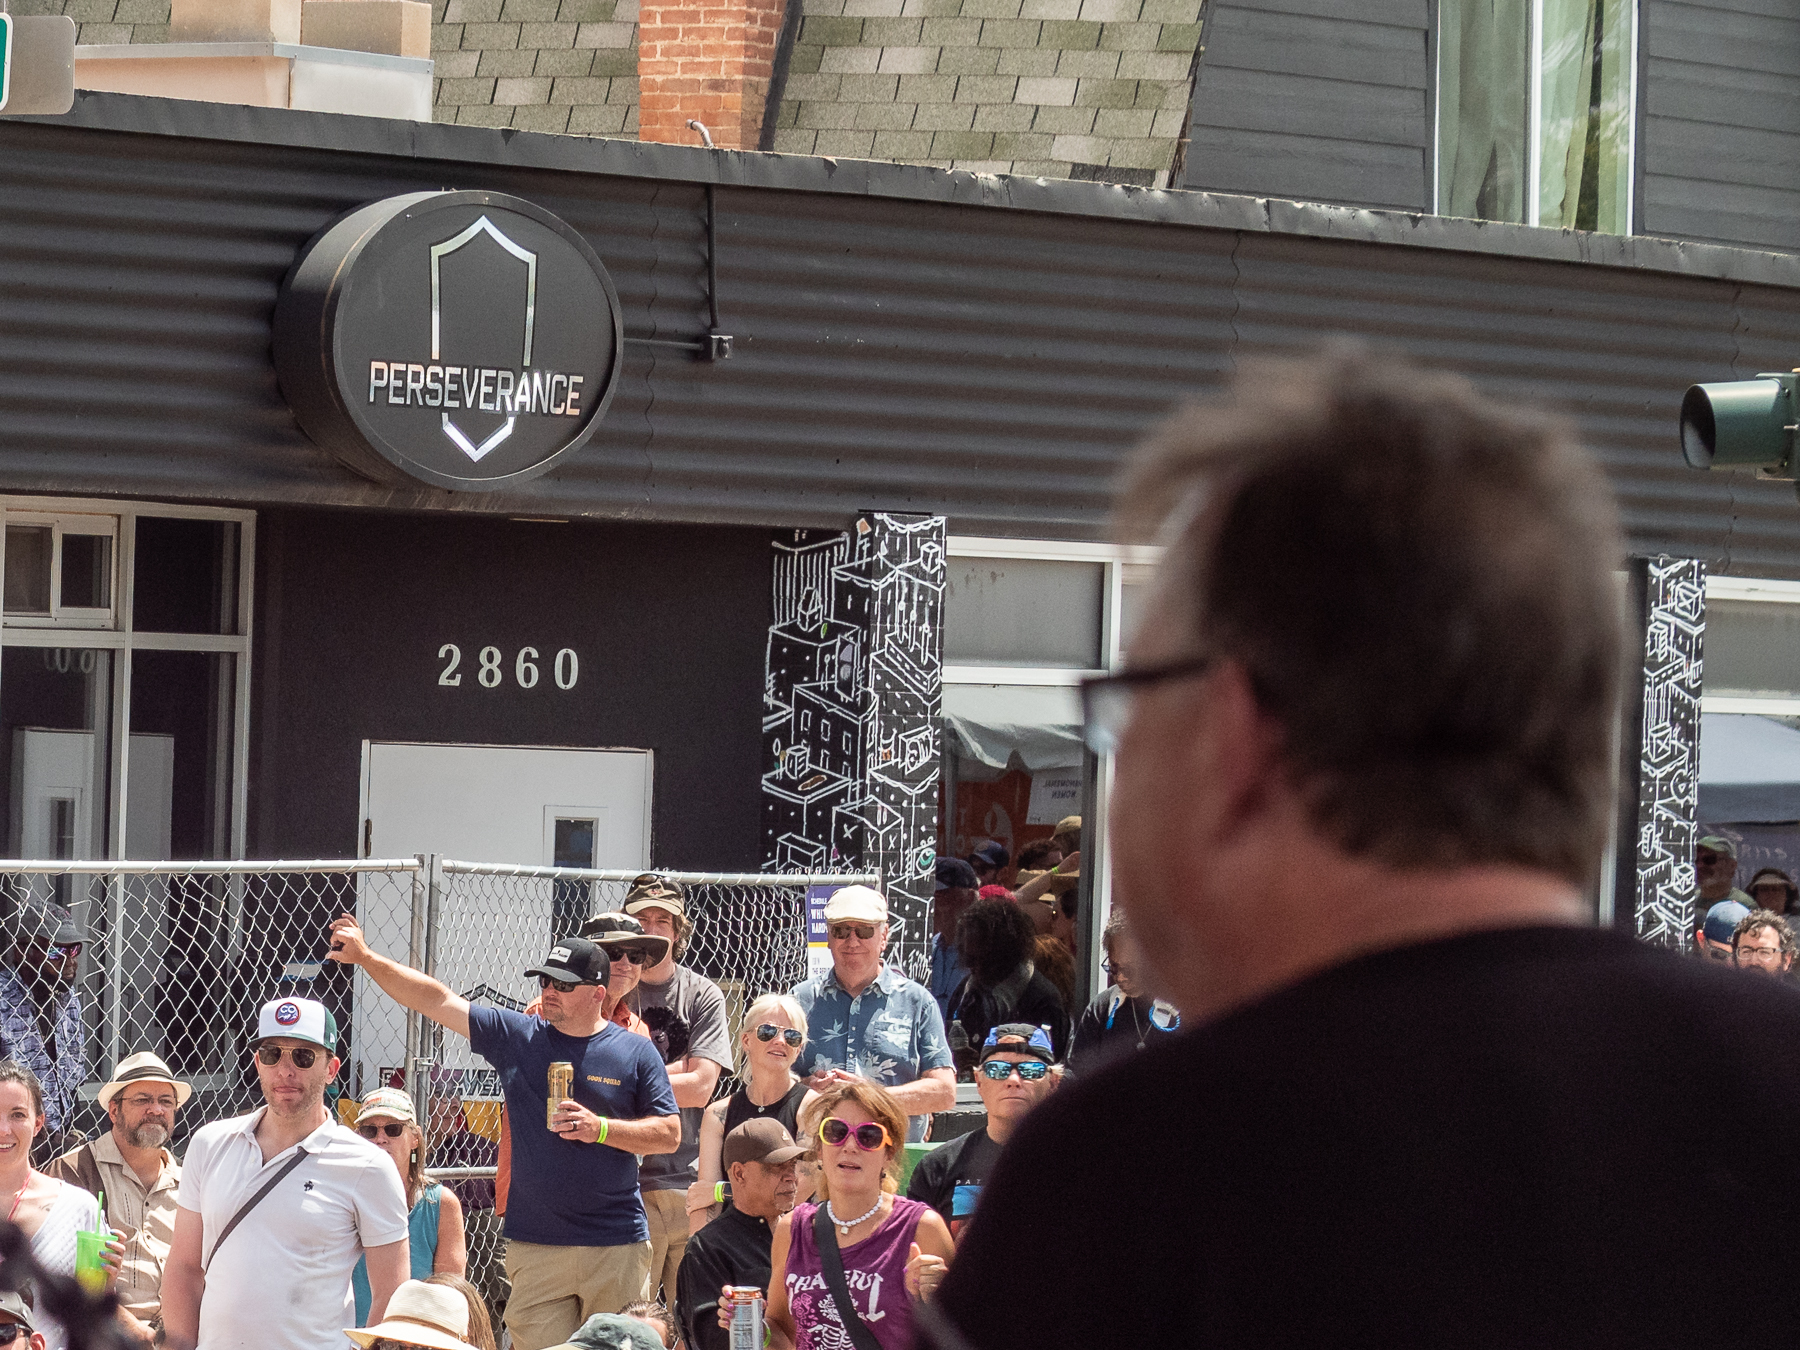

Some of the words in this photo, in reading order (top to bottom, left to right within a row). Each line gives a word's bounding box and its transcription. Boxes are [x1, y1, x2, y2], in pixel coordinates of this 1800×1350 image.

[369, 361, 584, 415] PERSEVERANCE
[438, 643, 579, 690] 2860
[280, 1005, 296, 1014] CO
